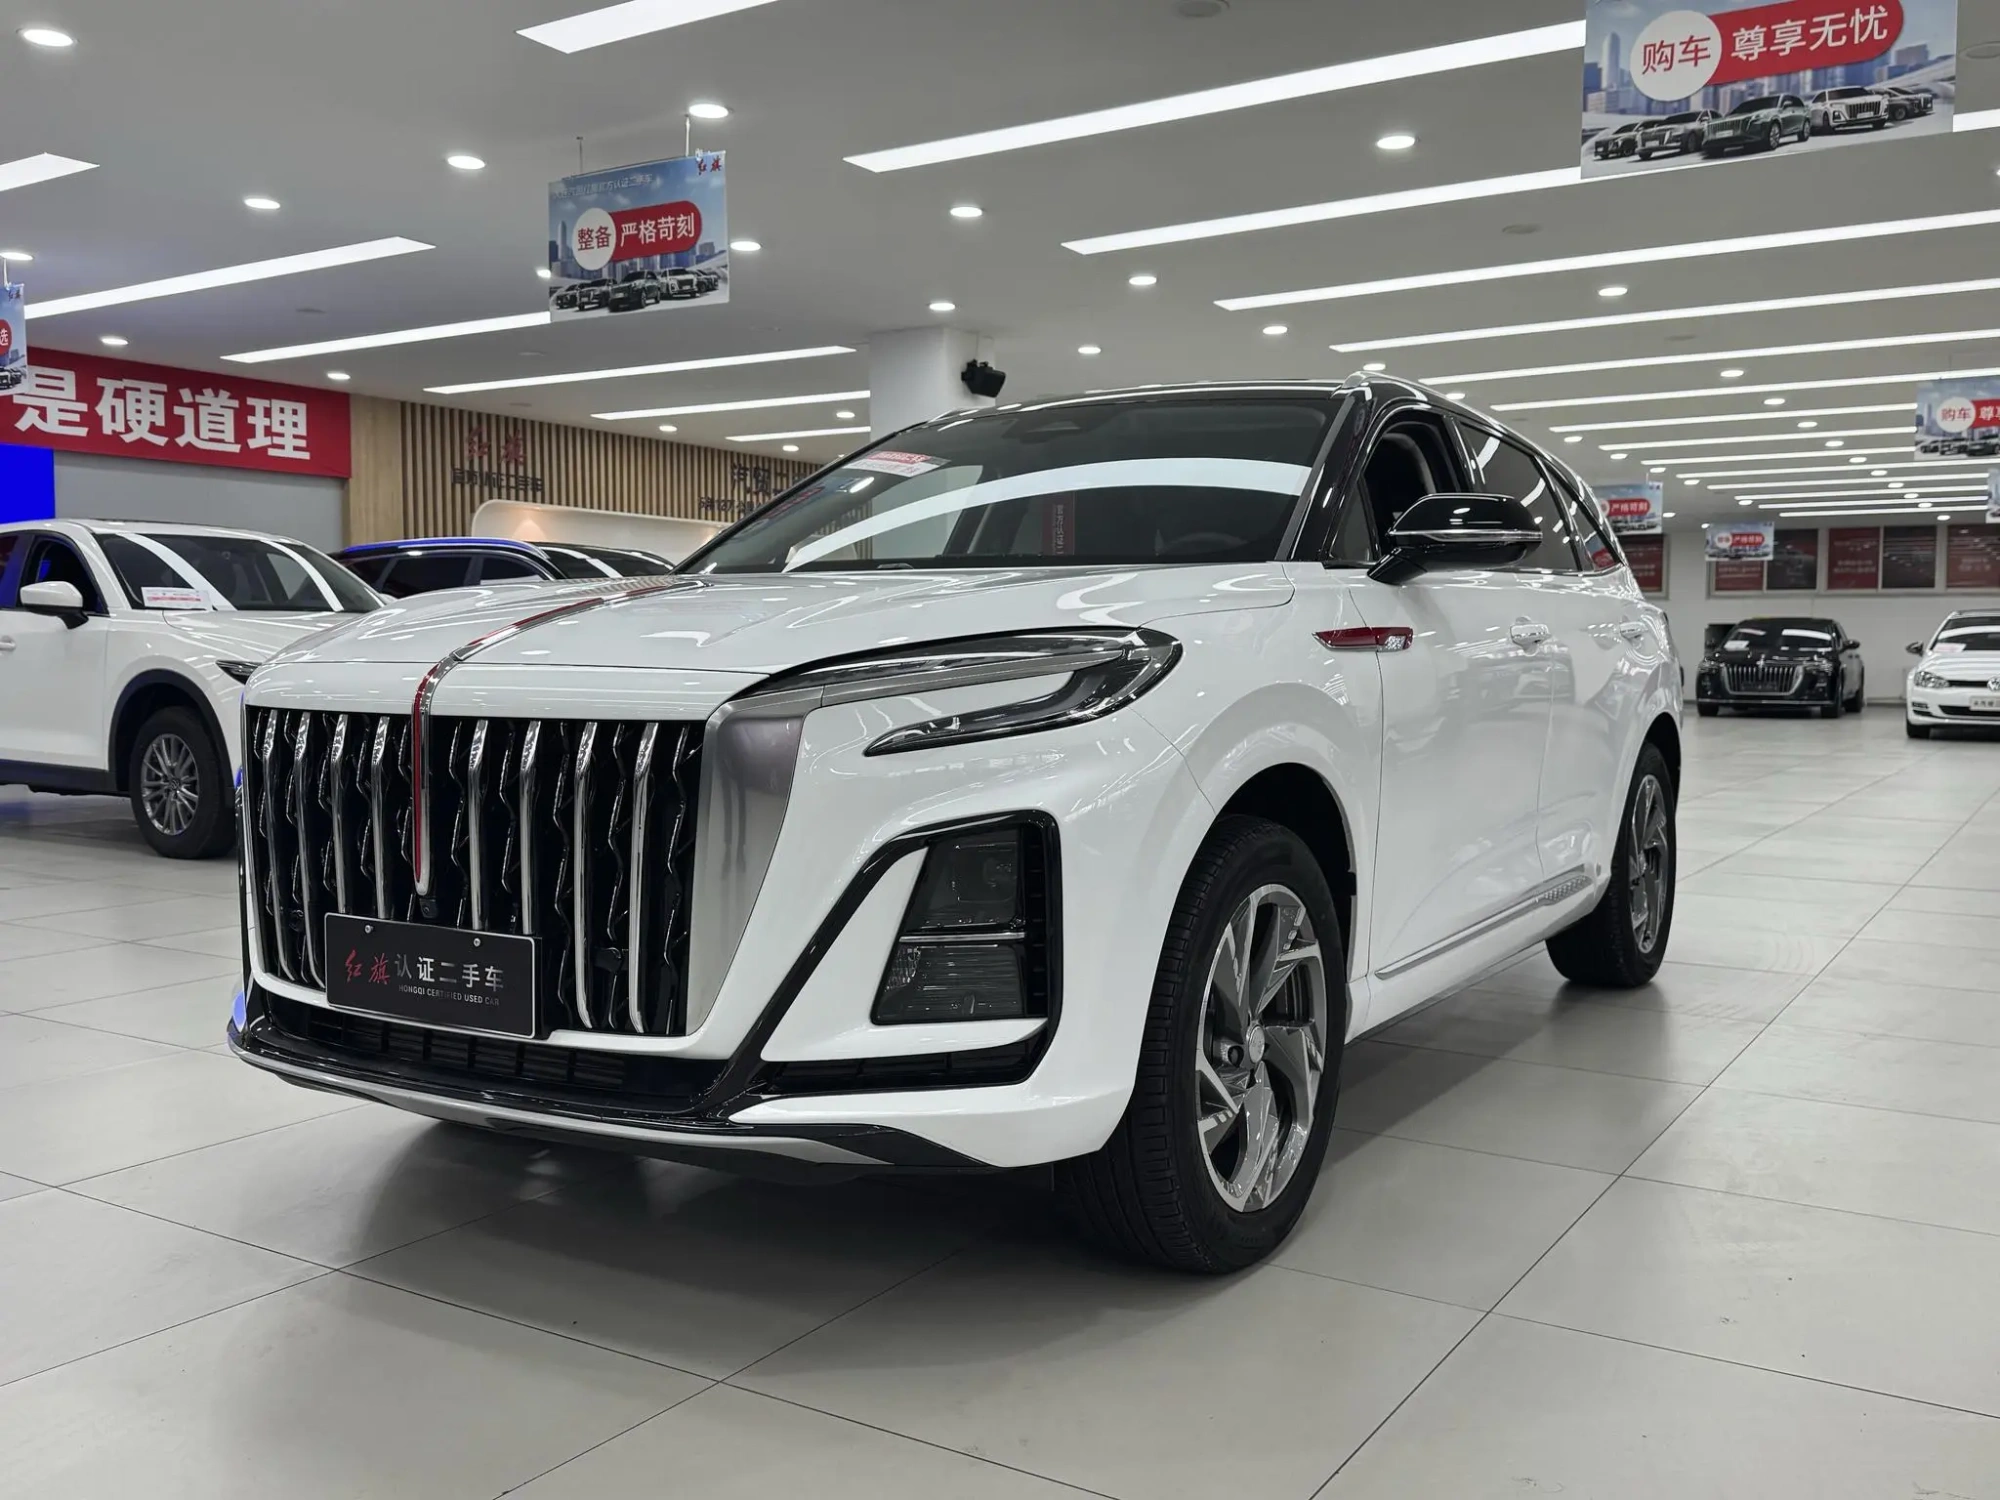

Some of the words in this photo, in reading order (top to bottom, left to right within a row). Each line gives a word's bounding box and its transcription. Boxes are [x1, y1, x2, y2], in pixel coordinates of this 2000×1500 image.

[1642, 35, 1712, 75] 购车
[1731, 7, 1888, 61] 尊享无忧
[577, 225, 612, 252] 整备
[620, 212, 695, 247] 严格苛刻
[13, 365, 311, 460] 是硬道理
[1941, 407, 1972, 421] 购车
[399, 984, 426, 996] HONGQI
[427, 987, 462, 1001] CERTIFIED
[464, 993, 483, 1005] USED
[484, 996, 500, 1007] CAR
